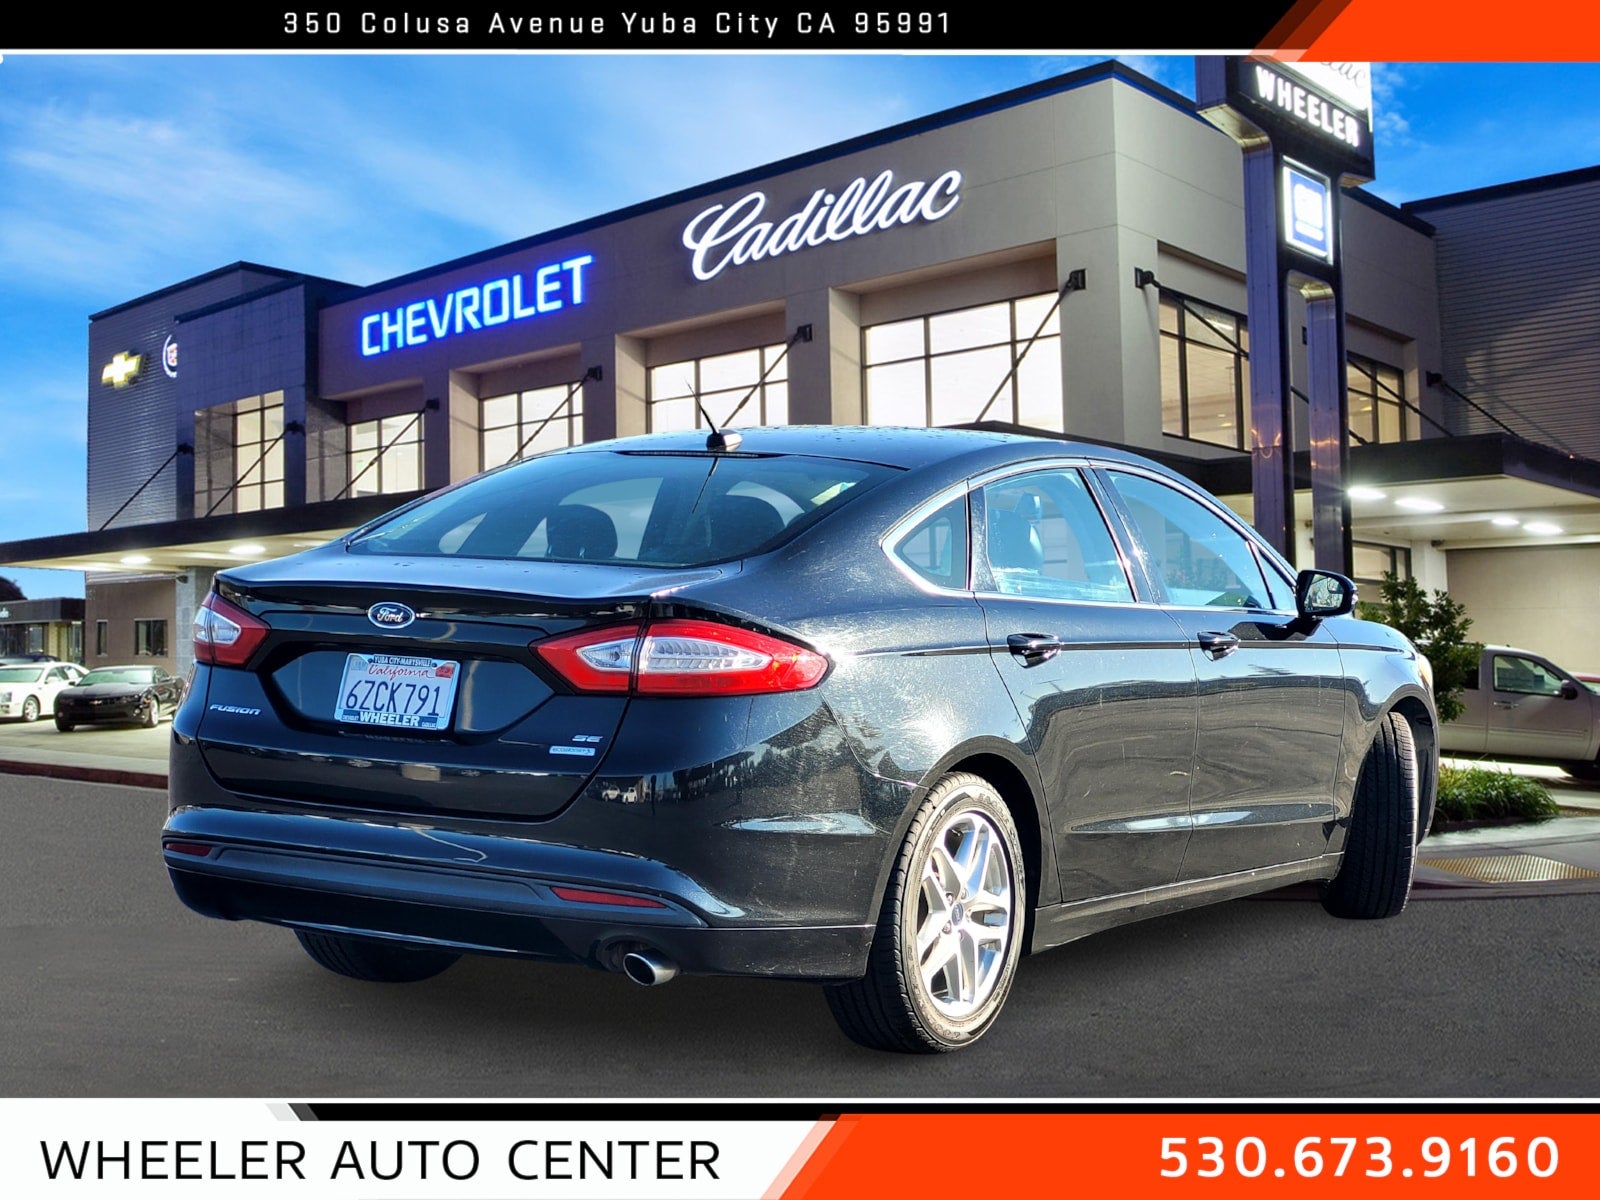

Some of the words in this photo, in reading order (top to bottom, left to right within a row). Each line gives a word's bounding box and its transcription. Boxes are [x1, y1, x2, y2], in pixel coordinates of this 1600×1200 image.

[1256, 65, 1360, 147] WHEELER
[682, 168, 962, 281] Cadillac
[361, 254, 594, 357] CHEVROLET
[376, 606, 404, 623] Ford
[368, 664, 435, 681] California
[345, 680, 441, 716] 6ZCK791
[209, 703, 262, 716] FUSION
[359, 711, 421, 727] WHEELER
[571, 734, 604, 743] SE
